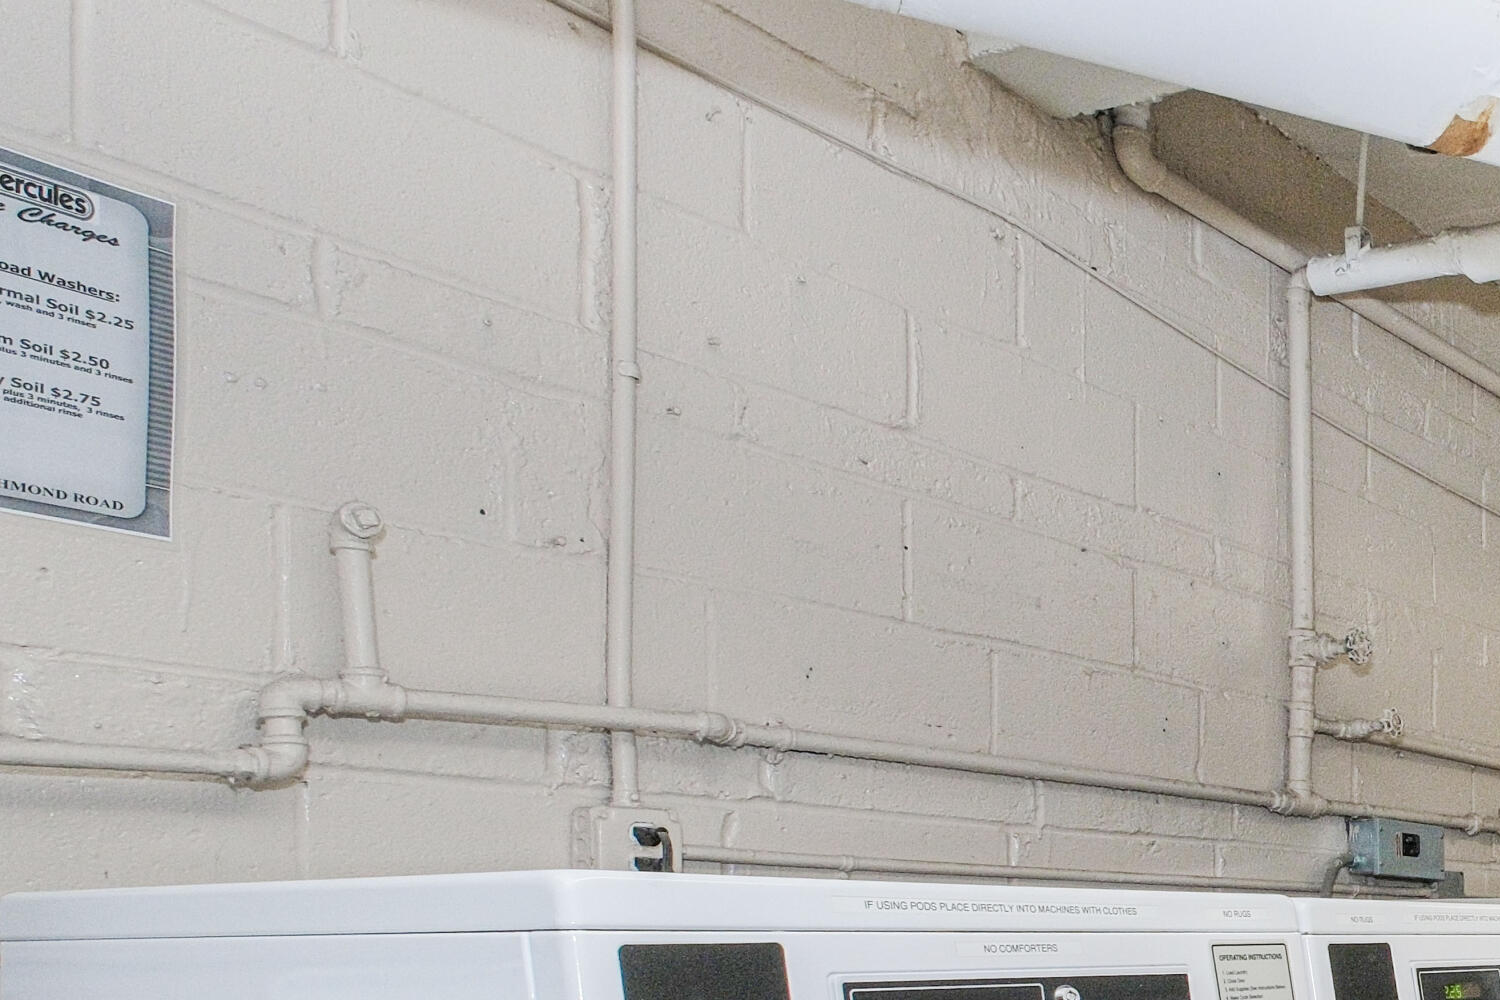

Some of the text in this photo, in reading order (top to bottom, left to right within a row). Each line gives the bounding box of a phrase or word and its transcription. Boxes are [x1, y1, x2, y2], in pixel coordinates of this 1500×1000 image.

[18, 208, 119, 246] Charges
[38, 270, 119, 301] Washers:
[5, 300, 32, 311] wash
[36, 308, 54, 318] and
[67, 316, 96, 328] rinses
[46, 298, 78, 315] Soil
[86, 310, 134, 330] $2.25
[20, 338, 53, 356] Soil
[60, 349, 109, 369] $2.50
[30, 354, 71, 368] minutes
[74, 365, 92, 374] and
[104, 372, 133, 384] rinses
[2, 388, 24, 398] plus
[37, 396, 80, 411] minutes,
[96, 410, 125, 420] rinses
[10, 377, 101, 406] Soil $2.75
[4, 396, 83, 418] additional rinse
[74, 492, 124, 510] ROAD
[864, 900, 1137, 915] IF USING PODS PLACE DIRECTLY INTO MACHINES WITH CLOTHES
[983, 944, 1058, 953] NO COMFORTERS
